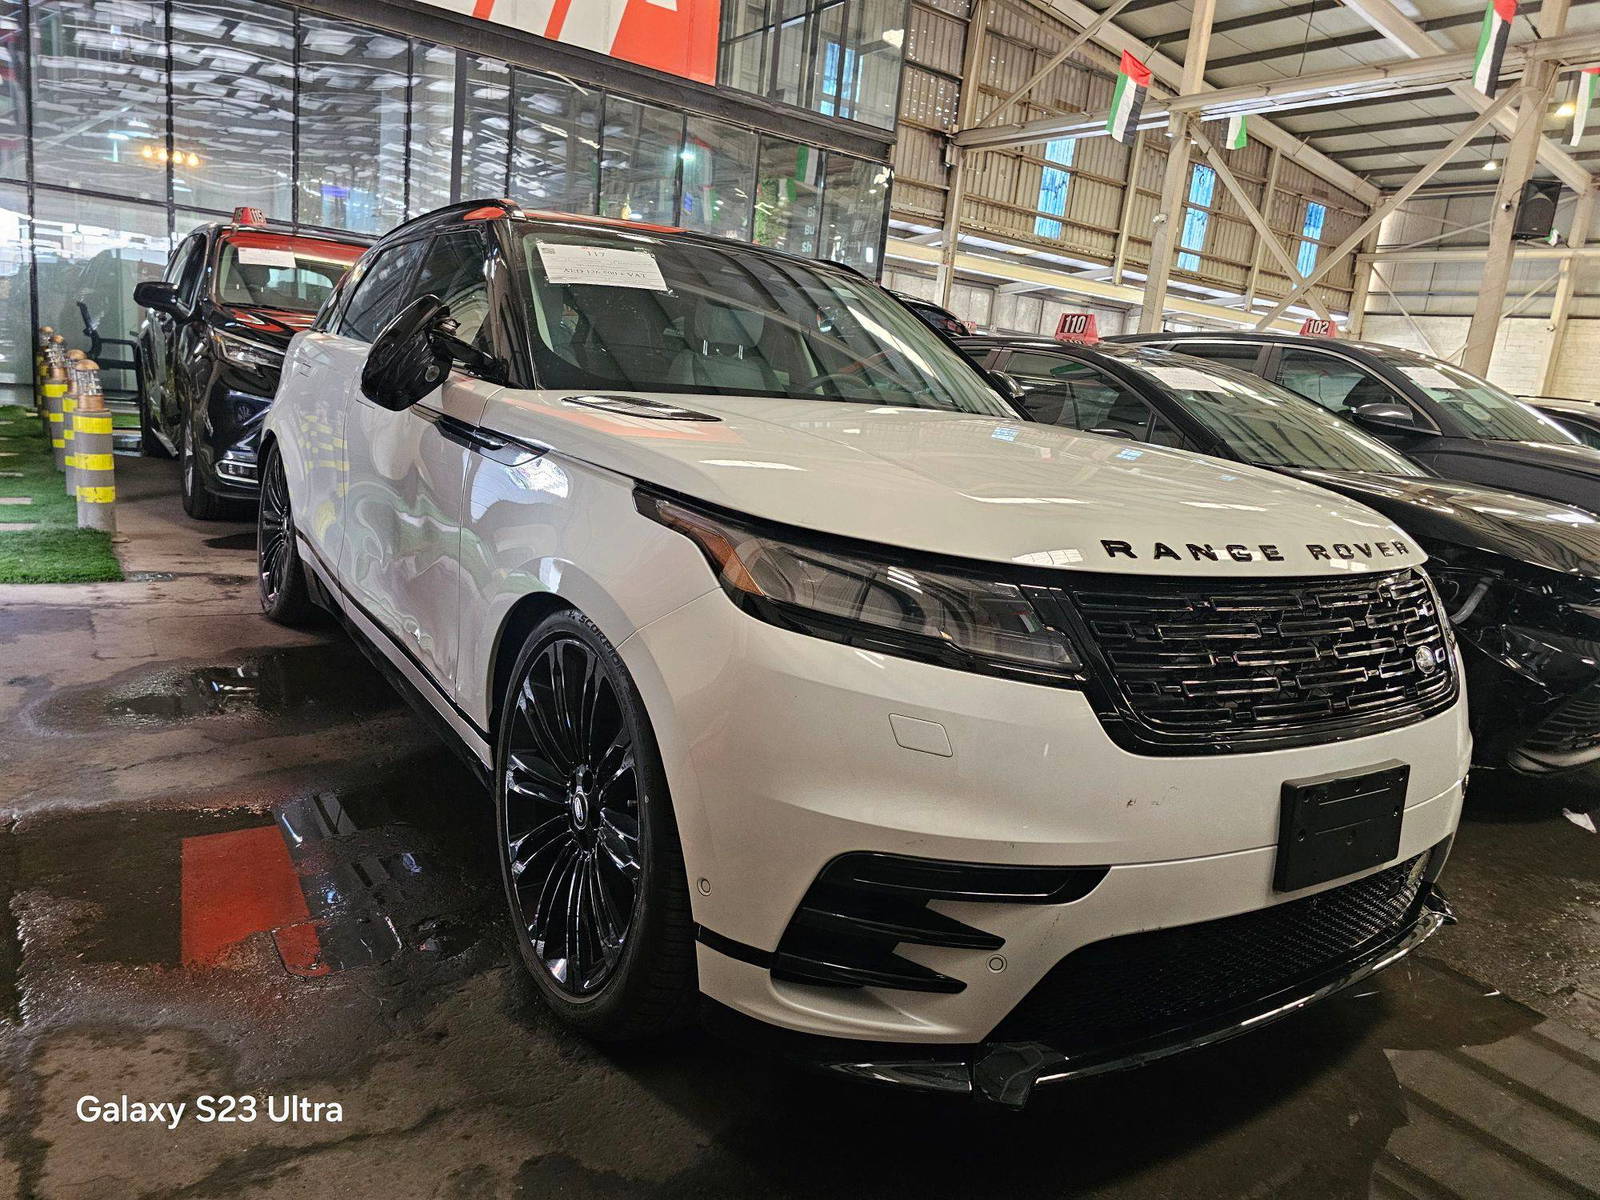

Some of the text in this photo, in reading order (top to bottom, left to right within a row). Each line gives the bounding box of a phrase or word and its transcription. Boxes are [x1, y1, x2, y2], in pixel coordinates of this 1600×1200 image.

[1063, 315, 1087, 334] 110
[1307, 319, 1330, 335] 102
[1100, 539, 1410, 562] RANGE ROVER
